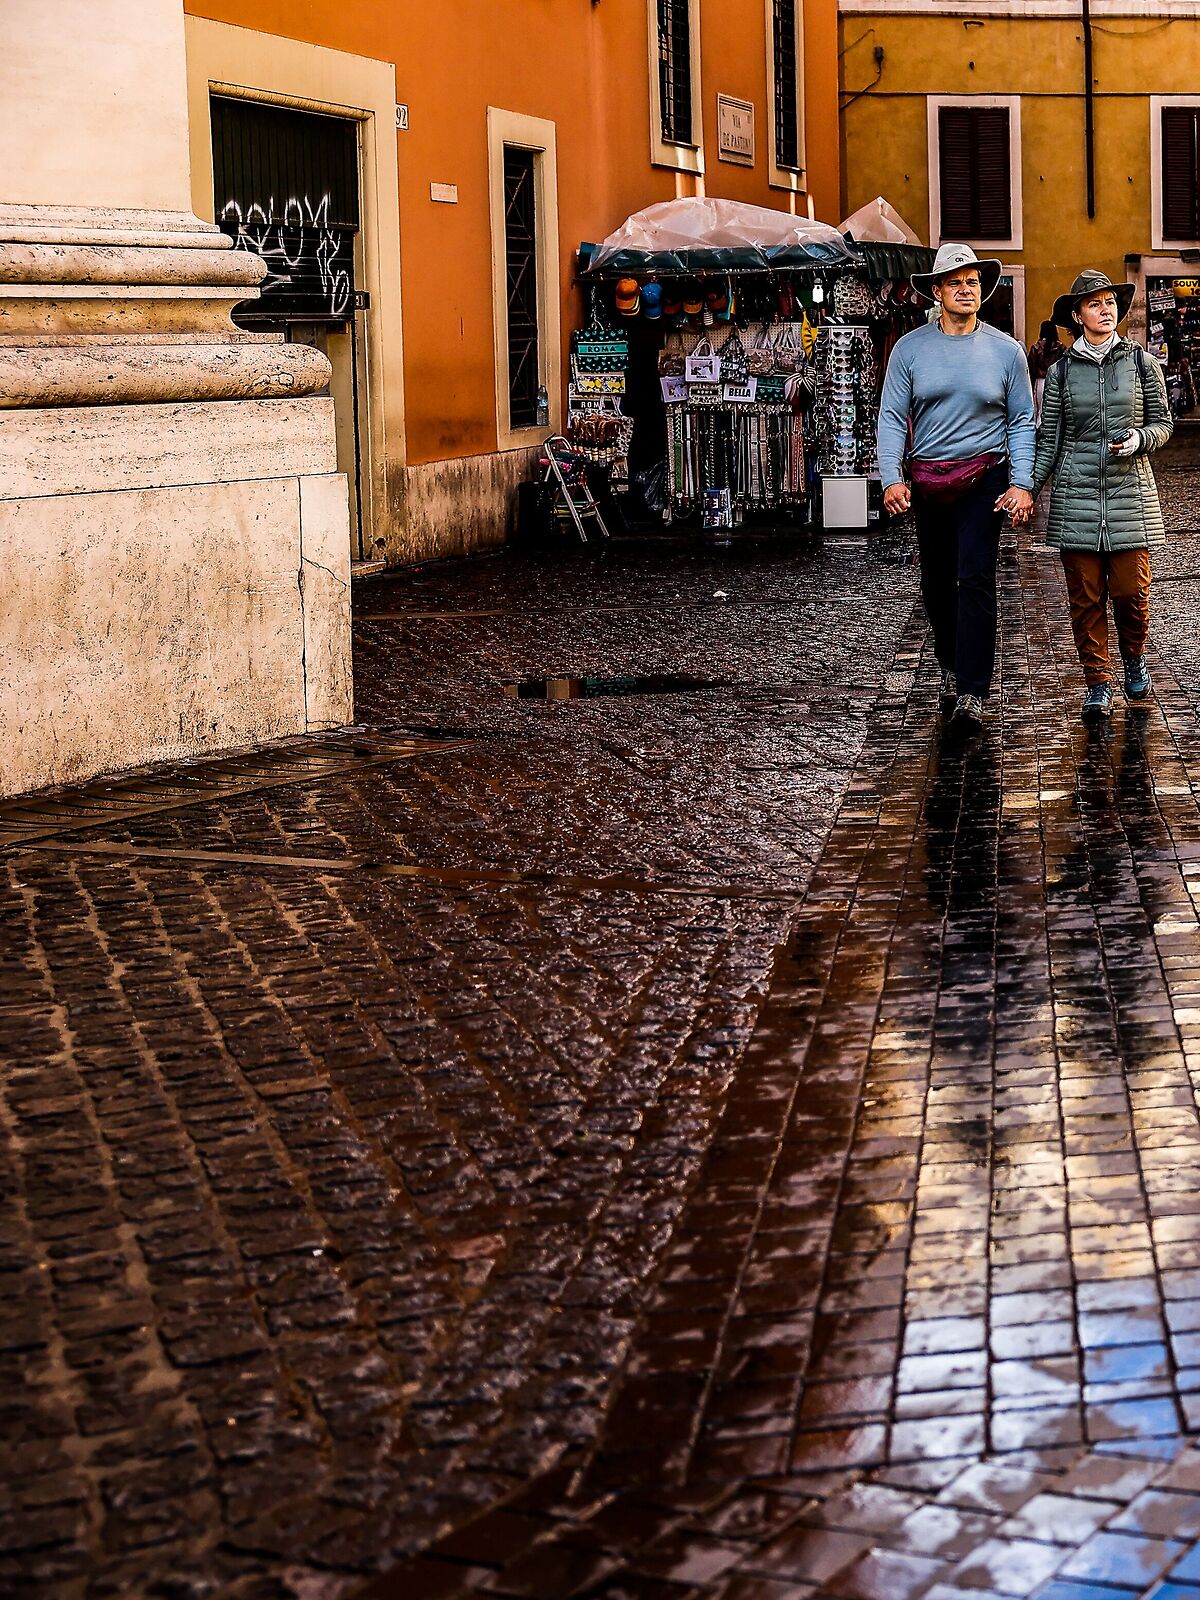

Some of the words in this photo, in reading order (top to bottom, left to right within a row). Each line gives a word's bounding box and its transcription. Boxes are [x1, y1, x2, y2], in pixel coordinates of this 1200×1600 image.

[396, 107, 406, 126] 92
[732, 114, 741, 128] VIA
[729, 387, 751, 397] BELLA
